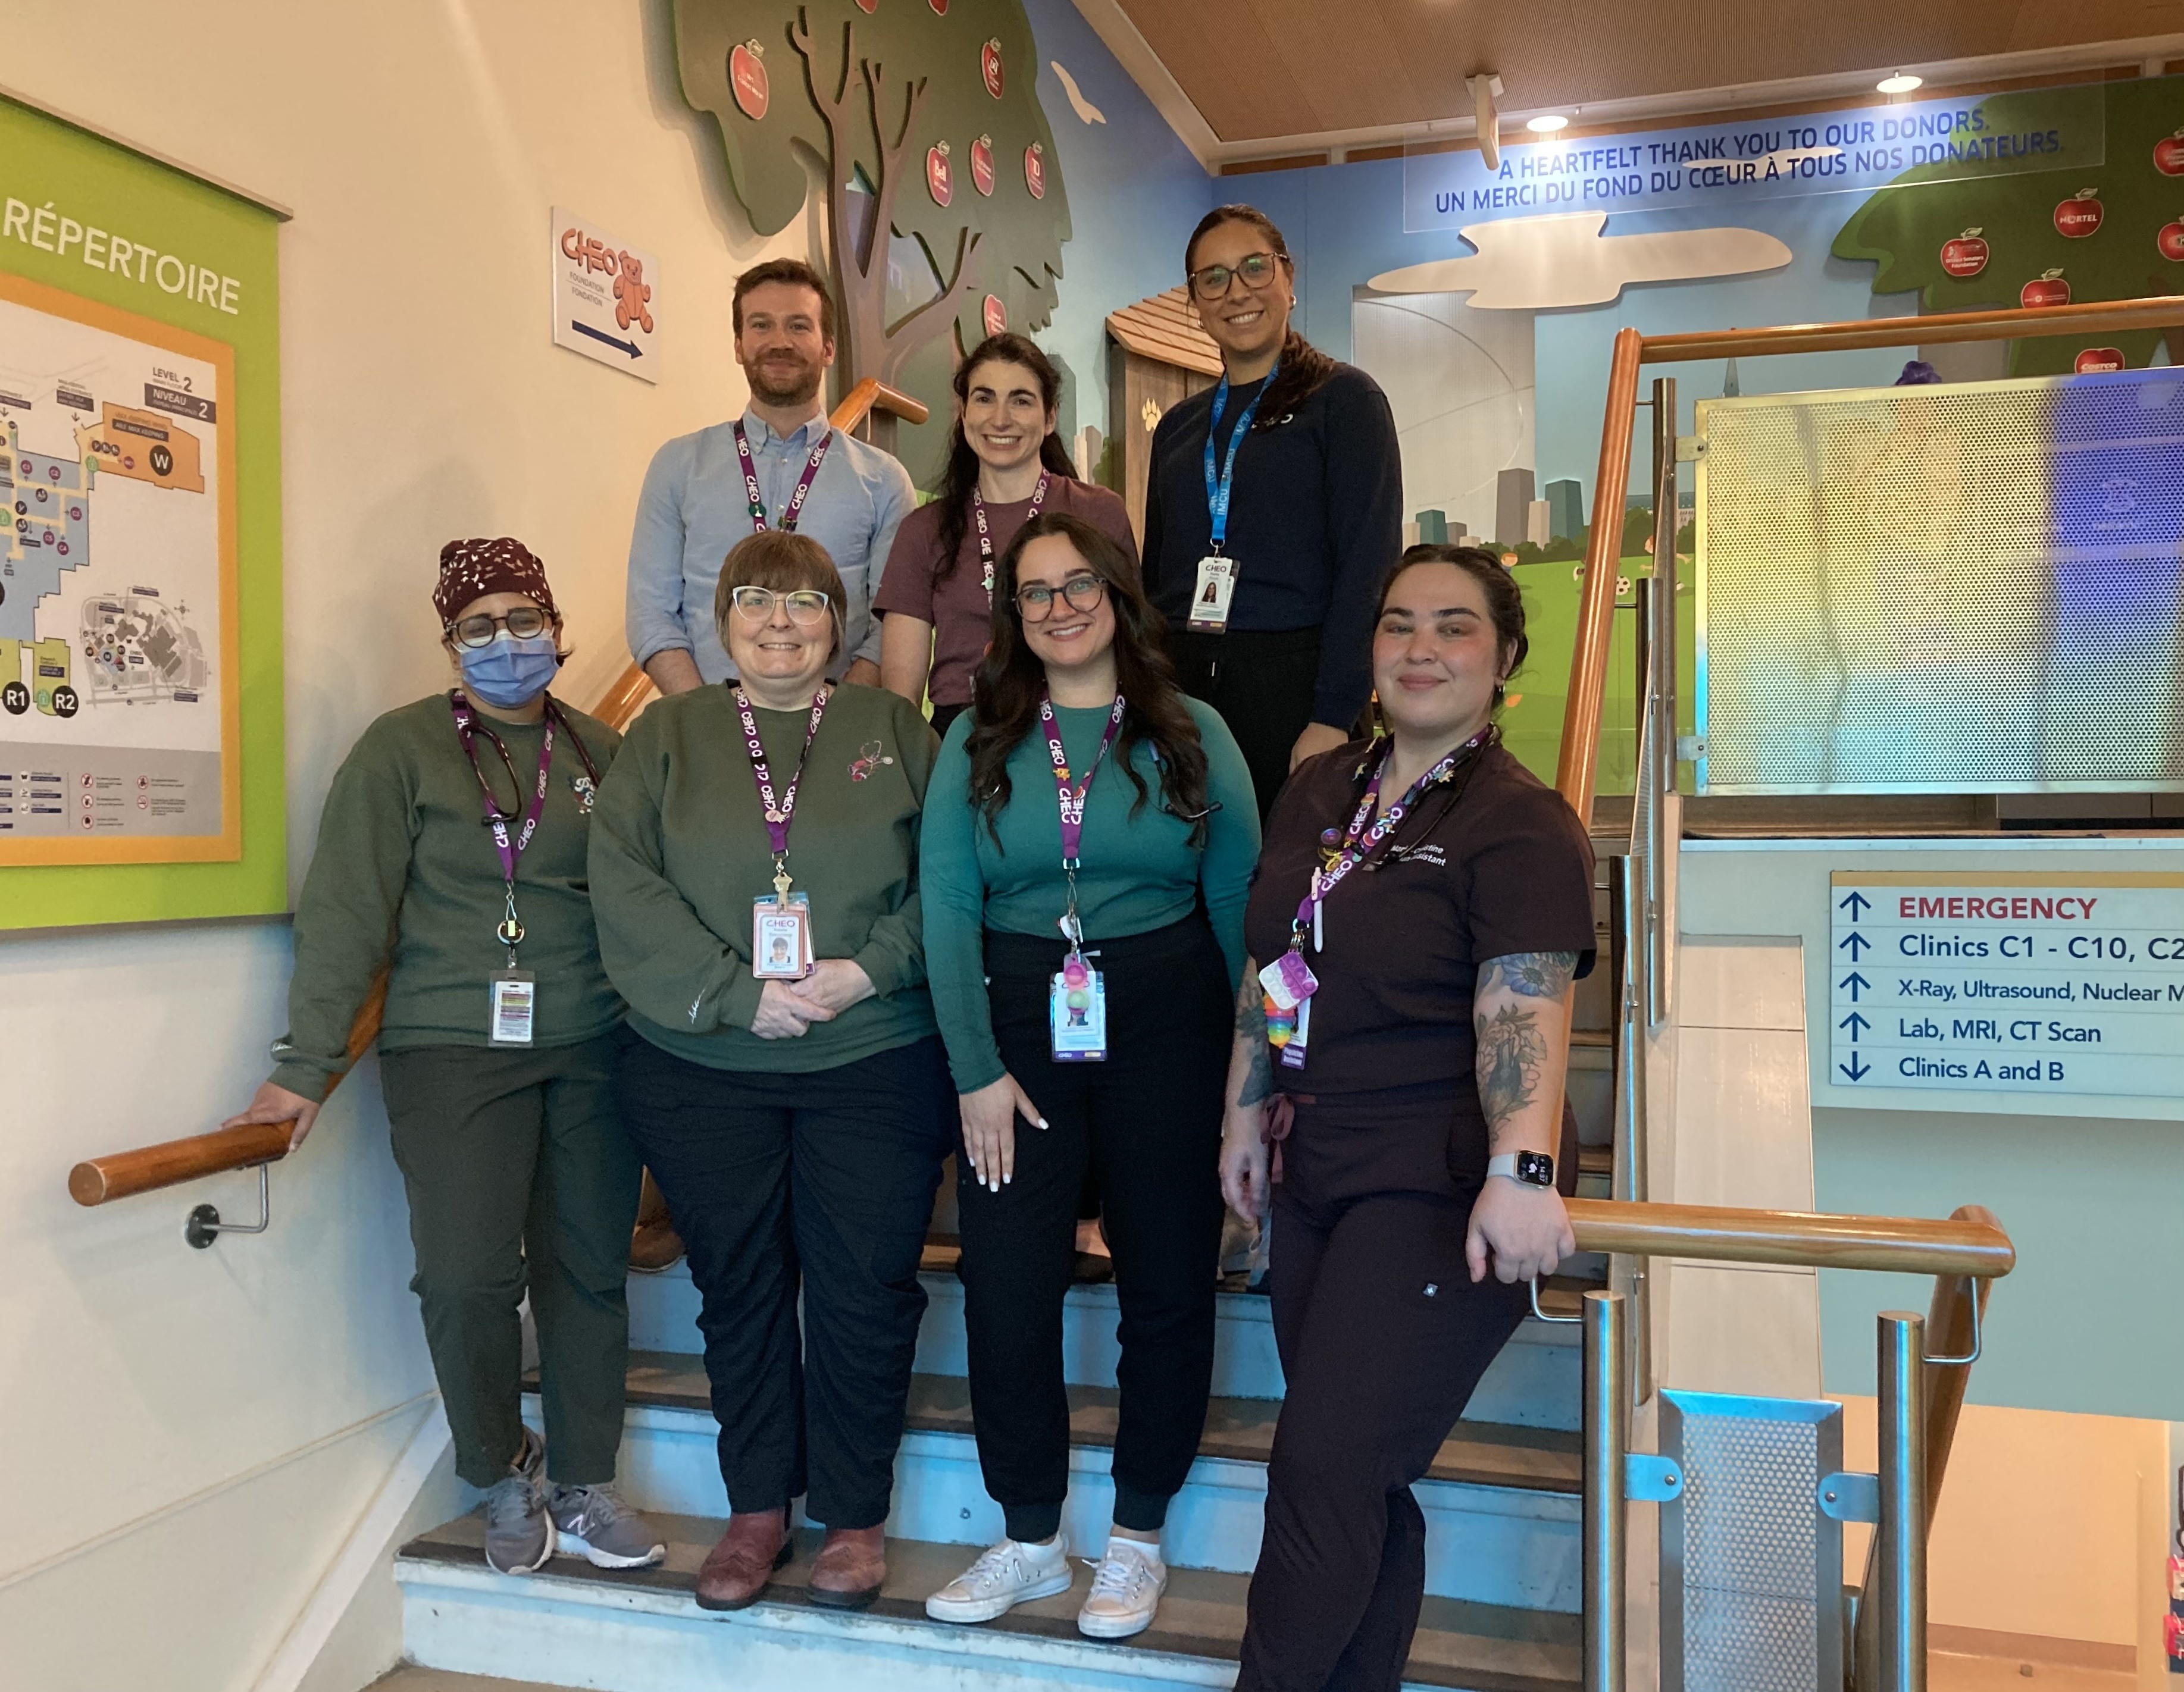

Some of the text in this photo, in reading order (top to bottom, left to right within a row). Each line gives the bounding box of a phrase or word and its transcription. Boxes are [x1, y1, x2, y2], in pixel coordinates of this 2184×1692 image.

[1498, 108, 1990, 180] A HEARTFELT THANK YOU TO OUR DONORS.
[934, 159, 947, 182] Bell
[1031, 157, 1040, 177] TD
[1436, 129, 2064, 214] UN MERCI DU FOND DU CŒUR À TOUS NOS DONATEURS.
[2060, 213, 2098, 224] NORTEL
[2, 197, 241, 315] RÉPERTOIRE
[561, 227, 618, 277] CHEO
[570, 271, 605, 294] FOUNDATION
[571, 286, 603, 308] FONDATION
[152, 366, 180, 383] LEVEL
[183, 376, 193, 393] 2
[153, 388, 187, 406] NIVEAU
[198, 402, 209, 419] 2
[737, 437, 749, 457] HEO
[154, 452, 170, 470] W
[746, 475, 760, 502] CHEO
[791, 483, 808, 510] CHEO
[1032, 479, 1047, 504] CHEO
[1217, 488, 1228, 515] IMCU
[975, 509, 988, 534] CHEO
[7, 690, 26, 706] R1
[55, 694, 76, 710] R2
[1112, 694, 1126, 724] CHEO
[741, 711, 757, 736] CHEO
[809, 707, 822, 734] CHEO
[1049, 739, 1066, 765] CHEO
[537, 769, 547, 799] CHEO
[761, 785, 777, 810] CHEO
[781, 785, 796, 813] CHEO
[517, 818, 536, 851] CHEO
[1321, 860, 1353, 892] CHEO
[1898, 897, 2098, 920] EMERGENCY
[766, 919, 796, 928] CHEO
[1898, 934, 1989, 957] Clinics
[1999, 936, 2035, 958] C1
[2068, 937, 2136, 963] C10,
[1898, 979, 1957, 1002] X-Ray,
[1963, 980, 2076, 1002] Ultrasound,
[2083, 983, 2162, 1002] Nuclear
[1899, 1018, 2102, 1044] Lab, MRI, CT Scan
[1898, 1057, 2065, 1081] Clinics A and B
